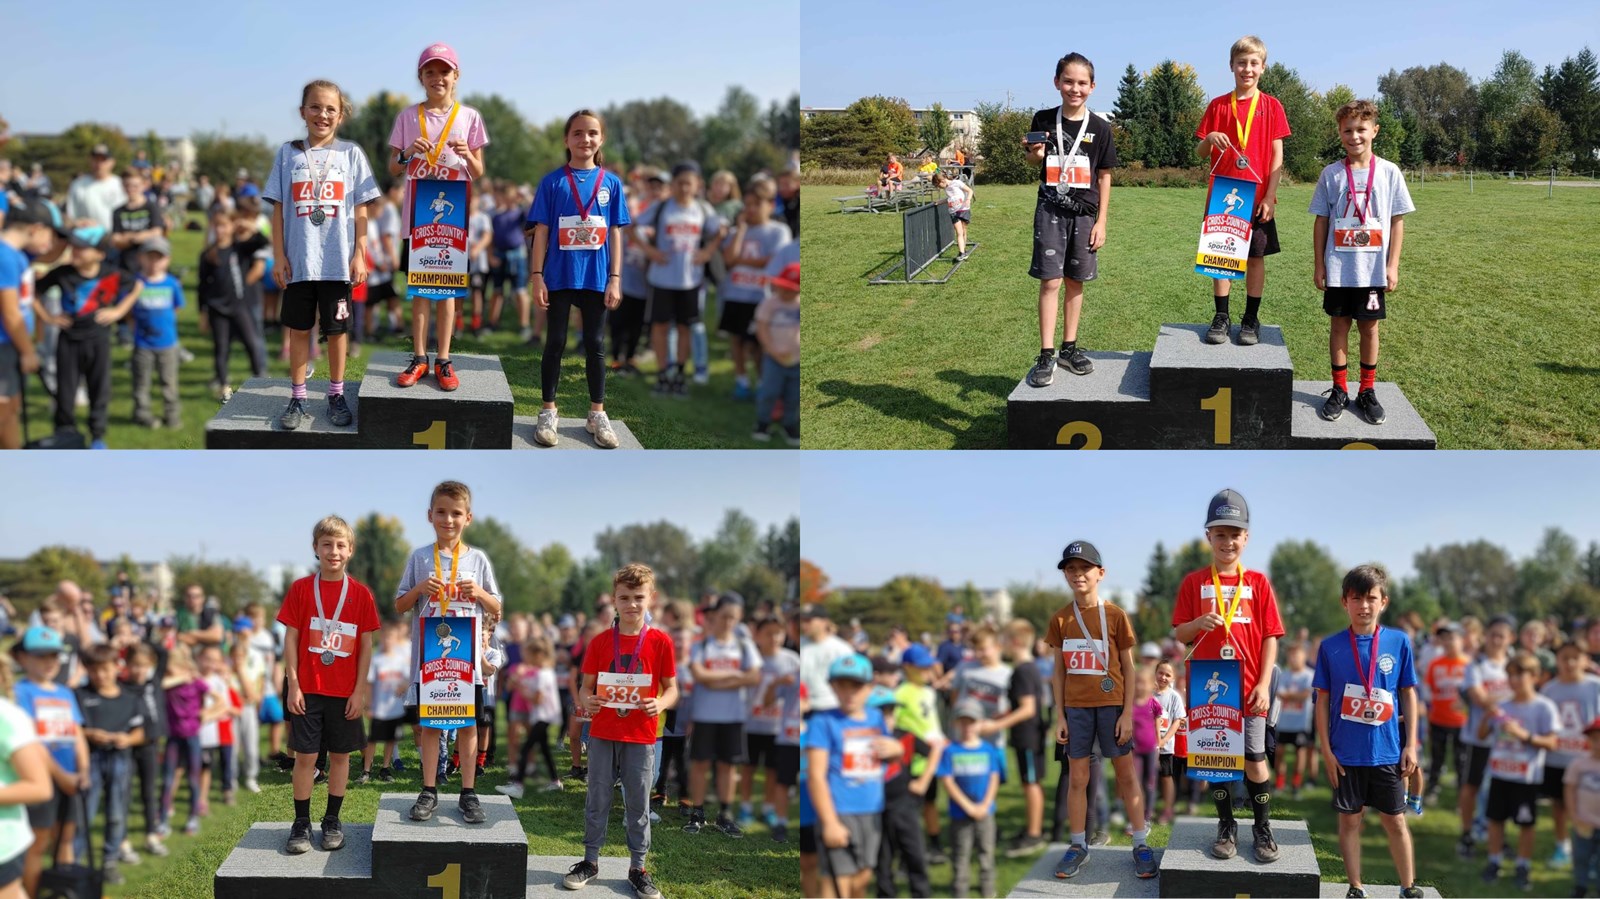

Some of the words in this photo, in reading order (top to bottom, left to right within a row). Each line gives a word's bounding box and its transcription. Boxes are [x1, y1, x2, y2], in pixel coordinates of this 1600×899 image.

[1081, 132, 1096, 143] AT
[300, 182, 335, 200] 48
[1207, 215, 1250, 233] CROSS-COUNTRY
[415, 224, 465, 241] CROSS-COUNTRY
[567, 227, 600, 245] 96
[1207, 225, 1247, 239] MOUSTIQUE
[424, 237, 454, 245] NOVICE
[1207, 242, 1237, 253] Sportive
[419, 258, 453, 266] Sportive
[1203, 254, 1240, 269] CHAMPION
[1203, 267, 1236, 277] 2023-2024
[411, 273, 465, 286] CHAMPIONNE
[1200, 387, 1232, 445] 1
[425, 659, 471, 674] CROSS-COUNTRY
[1069, 651, 1097, 669] 611
[434, 670, 462, 679] NOVICE
[429, 690, 462, 699] Sportive
[605, 686, 641, 703] 336
[427, 705, 468, 716] CHAMPION
[1191, 706, 1240, 722] CROSS-COUNTRY
[1200, 718, 1230, 727] NOVICE
[1196, 739, 1231, 748] Sportive
[1194, 755, 1237, 768] CHAMPION
[1196, 770, 1234, 778] 2023-2024
[427, 863, 461, 899] 1
